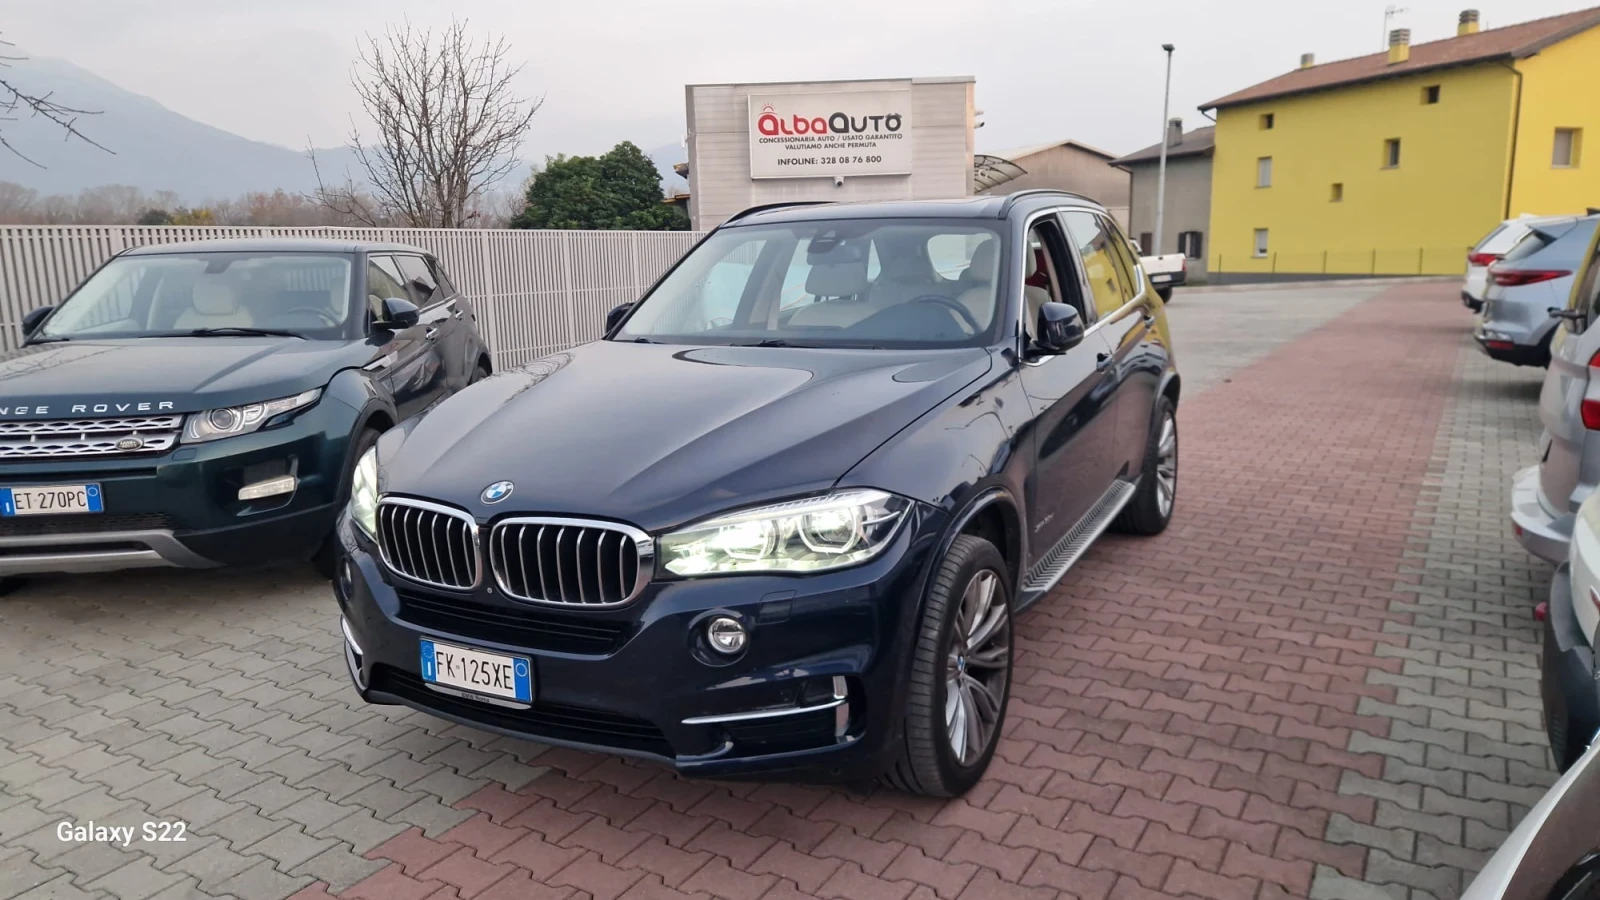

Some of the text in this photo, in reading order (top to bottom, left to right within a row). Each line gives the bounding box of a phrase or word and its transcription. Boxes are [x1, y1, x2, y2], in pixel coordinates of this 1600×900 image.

[759, 136, 815, 144] CONCESSIONARIA
[865, 133, 902, 141] GARANTITO
[777, 155, 882, 166] INFOLINE: 328 08 76 800
[71, 401, 174, 413] ROVER
